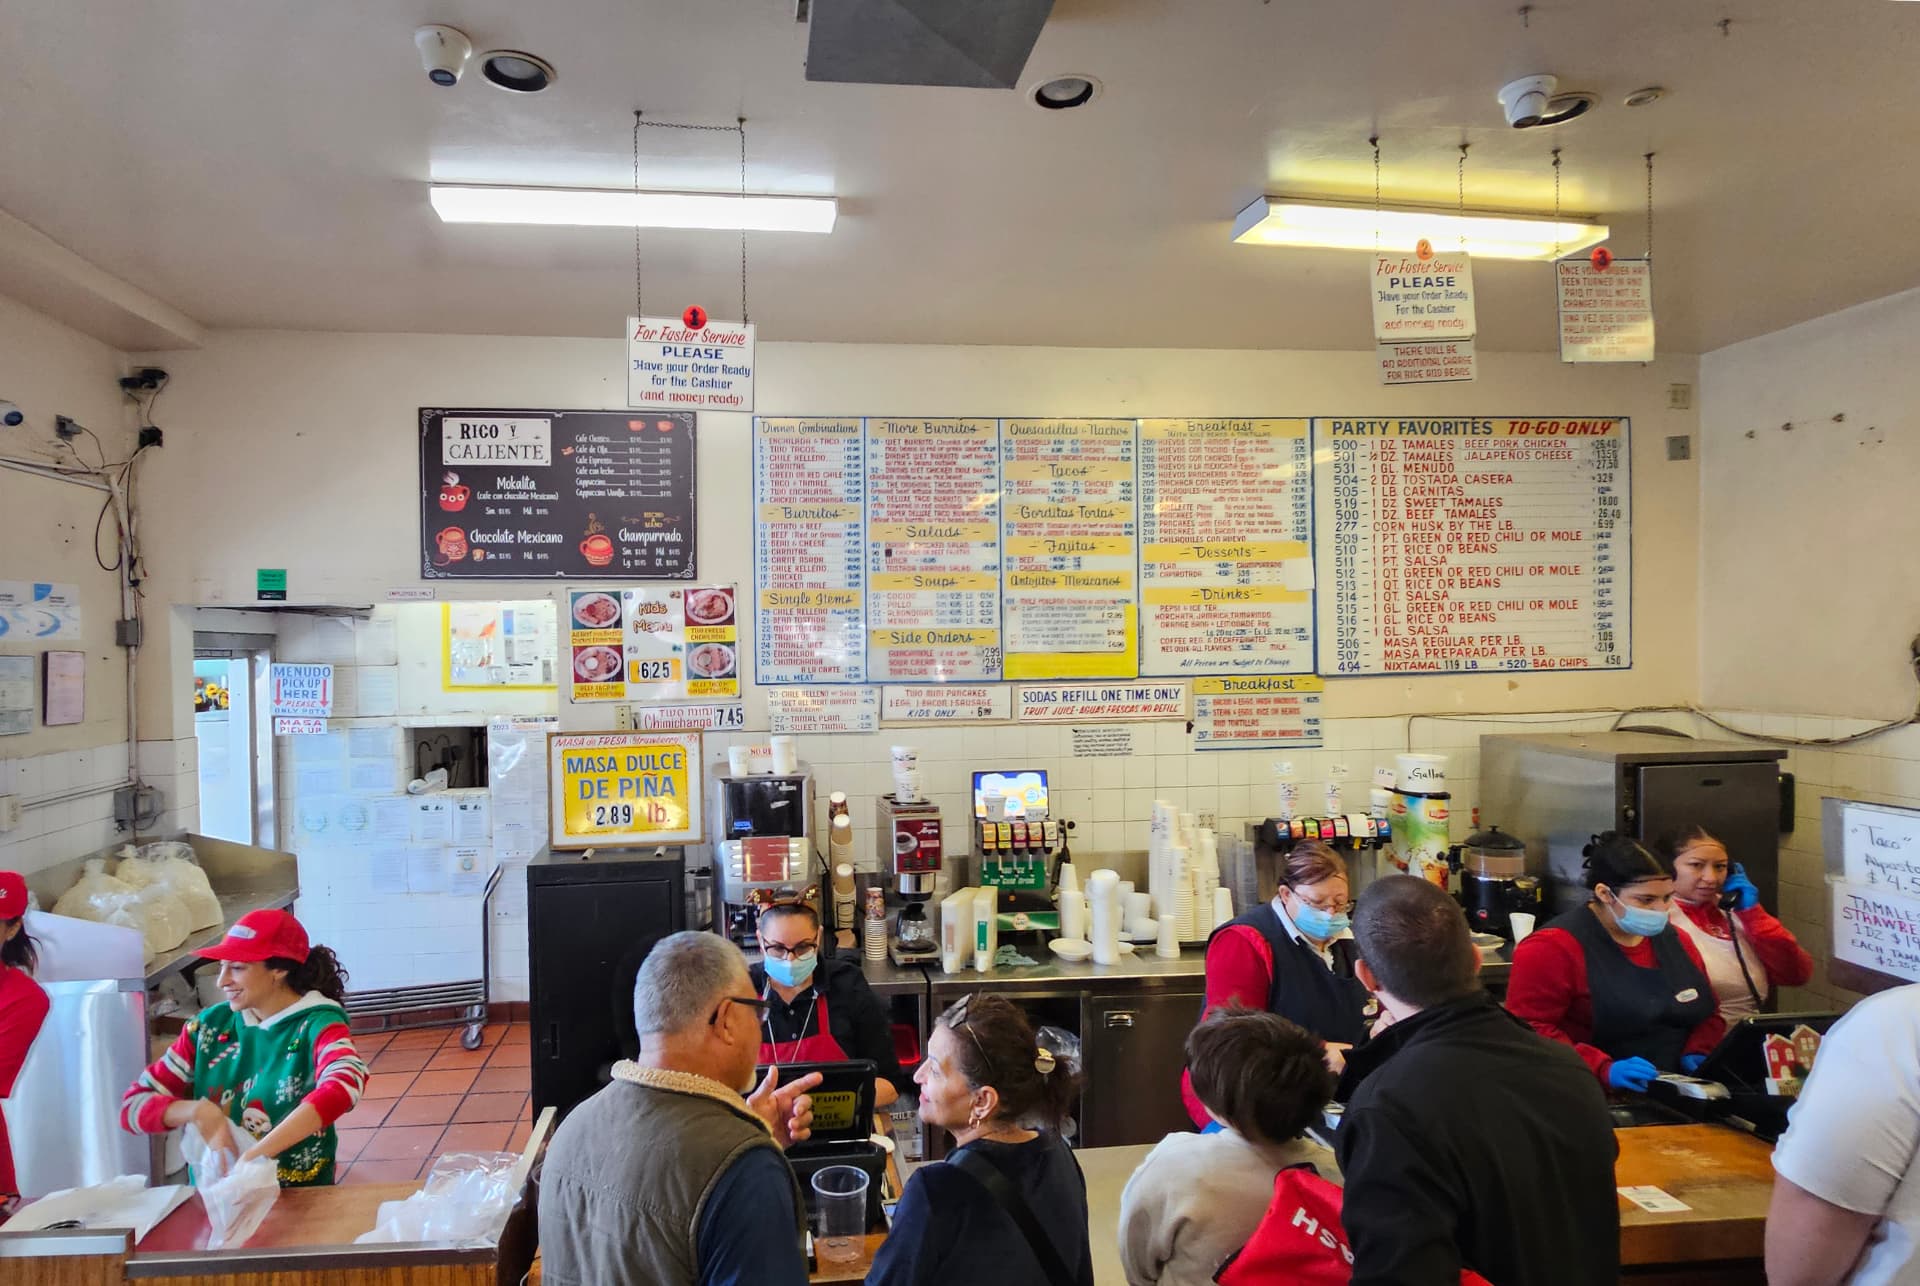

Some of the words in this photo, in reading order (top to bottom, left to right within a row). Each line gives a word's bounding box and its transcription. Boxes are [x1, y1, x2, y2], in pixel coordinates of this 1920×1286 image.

[1377, 258, 1397, 275] For
[1390, 276, 1455, 288] PLEASE
[690, 308, 699, 326] 1
[634, 325, 657, 340] For
[701, 328, 745, 345] Service
[662, 345, 724, 359] PLEASE
[633, 360, 663, 370] Have
[667, 363, 688, 374] your
[691, 363, 719, 374] Order
[722, 364, 750, 378] Ready
[651, 374, 667, 385] for
[671, 376, 687, 387] the
[691, 376, 733, 389] Cashier
[669, 392, 705, 404] money
[460, 423, 499, 440] RICO
[510, 425, 517, 437] Y
[762, 421, 795, 434] Dinner
[798, 421, 858, 434] Combinations
[887, 422, 919, 434] More
[925, 422, 977, 434] Burritos
[1188, 420, 1254, 432] Breakfast
[1332, 421, 1390, 435] PARTY
[1398, 421, 1493, 435] FAVORITES
[1509, 421, 1613, 435] TO-GO-ONLY
[1333, 440, 1358, 450] 500
[1402, 440, 1455, 450] TAMALES
[1464, 440, 1489, 448] BEEF
[1493, 440, 1519, 448] PORK
[1523, 439, 1567, 448] CHICKEN
[449, 444, 544, 460] CALIENTE
[1333, 451, 1355, 461] 501
[1402, 452, 1454, 461] TAMALES
[1535, 451, 1573, 459] CHEESE
[1333, 463, 1355, 473] 531
[1403, 463, 1455, 473] MENUDO
[497, 475, 536, 490] Mokalita
[1333, 475, 1358, 485] 504
[1402, 475, 1459, 485] TOSTADA
[1464, 474, 1514, 484] CASERA
[1335, 498, 1357, 509] 519
[1405, 498, 1446, 508] SWEET
[1452, 498, 1503, 507] TAMALES
[783, 507, 841, 520] Burritos
[1020, 505, 1074, 519] Gorditas
[1077, 505, 1115, 518] Tortas
[906, 526, 961, 539] Salads
[1336, 522, 1357, 532] 277
[1373, 522, 1405, 532] CORN
[1411, 521, 1444, 531] HUSK
[1449, 521, 1464, 531] BY
[1470, 521, 1492, 530] THE
[470, 530, 515, 544] Chocolate
[517, 530, 563, 544] Mexicano
[1335, 534, 1358, 544] 509
[1403, 533, 1441, 543] GREEN
[1447, 533, 1462, 542] OR
[1468, 533, 1490, 542] RED
[1495, 532, 1524, 542] CHILI
[1530, 532, 1546, 541] OR
[1552, 531, 1583, 541] MOLE
[1193, 546, 1253, 558] Desserts
[913, 576, 958, 589] Soups
[769, 592, 810, 607] Single
[816, 592, 852, 605] Items
[1200, 588, 1250, 600] Drinks
[638, 601, 668, 615] Kids
[890, 631, 923, 644] Side
[927, 631, 975, 644] Orders
[1337, 639, 1360, 649] 506
[1384, 638, 1418, 648] MASA
[1423, 636, 1474, 647] REGULAR
[1480, 636, 1503, 645] PER
[273, 666, 331, 677] MENUDO
[1338, 662, 1360, 672] 494
[1384, 661, 1441, 671] NIXTAMAL
[282, 679, 305, 688] PICK
[308, 679, 321, 689] UP
[1222, 679, 1295, 690] Breakfast
[284, 690, 318, 699] HERE
[1023, 691, 1057, 703] SODAS
[1062, 690, 1098, 702] REFILL
[1101, 690, 1122, 701] ONE
[1125, 689, 1151, 700] TIME
[1154, 688, 1180, 699] ONLY
[659, 709, 684, 717] TWO
[907, 709, 931, 717] KIDS
[934, 709, 957, 717] ONLY
[1024, 706, 1049, 716] FRUIT
[1052, 706, 1075, 715] JUICE
[1079, 705, 1105, 714] AGUAS
[1106, 704, 1138, 714] FRESCAS
[644, 712, 713, 729] Chimichanga
[280, 726, 304, 734] PICK
[598, 736, 627, 746] FRESA
[567, 756, 618, 774] MASA
[626, 753, 683, 772] DULCE
[579, 779, 609, 800] DE
[619, 772, 676, 798] PIÑA
[596, 804, 632, 826] 2.89
[1851, 938, 1884, 954] EACH
